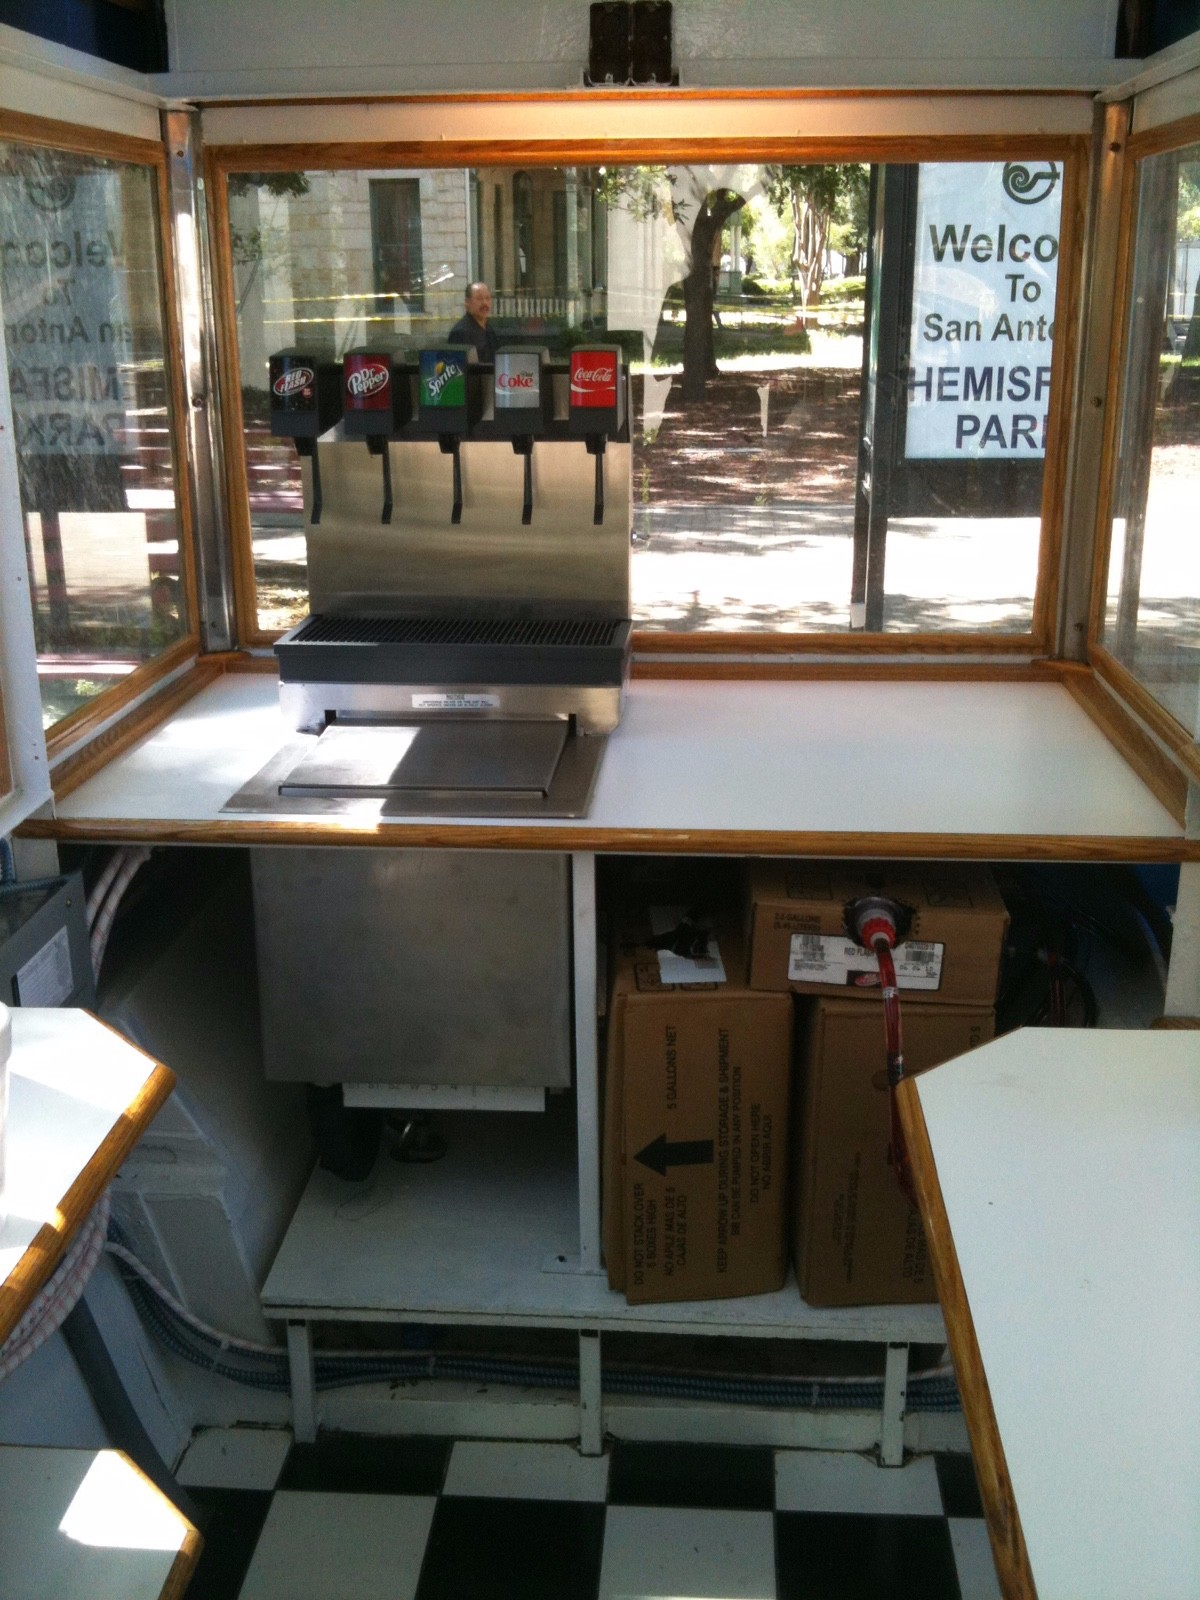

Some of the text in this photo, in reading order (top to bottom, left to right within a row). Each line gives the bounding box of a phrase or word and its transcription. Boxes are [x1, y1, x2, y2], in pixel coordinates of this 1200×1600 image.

[929, 224, 1059, 263] Welco
[1005, 274, 1042, 303] To
[923, 312, 1054, 342] San Ant
[350, 372, 387, 395] Pepper
[359, 368, 376, 380] Dr
[428, 363, 457, 397] Sprite
[498, 373, 534, 388] Coke
[955, 414, 1049, 450] PAR
[665, 1024, 677, 1110] 5 GALLONS NET
[733, 1066, 742, 1111] POSITION
[732, 1114, 741, 1132] ANY
[717, 1028, 729, 1273] KEEP ARROW UP DURING STORAGE & SHIPMENT
[750, 1103, 761, 1204] DO NOT OPEN HERE
[732, 1147, 741, 1185] PUMPED
[732, 1187, 741, 1199] BE
[761, 1174, 771, 1190] NO
[646, 1199, 657, 1225] HIGH
[665, 1195, 675, 1209] DE
[731, 1201, 741, 1219] CAN
[633, 1183, 644, 1286] DO NOT STACK OVER
[664, 1212, 675, 1233] MAS
[676, 1195, 687, 1266] CAJAS DE ALTO
[646, 1227, 657, 1260] BOXES
[663, 1262, 674, 1277] NO
